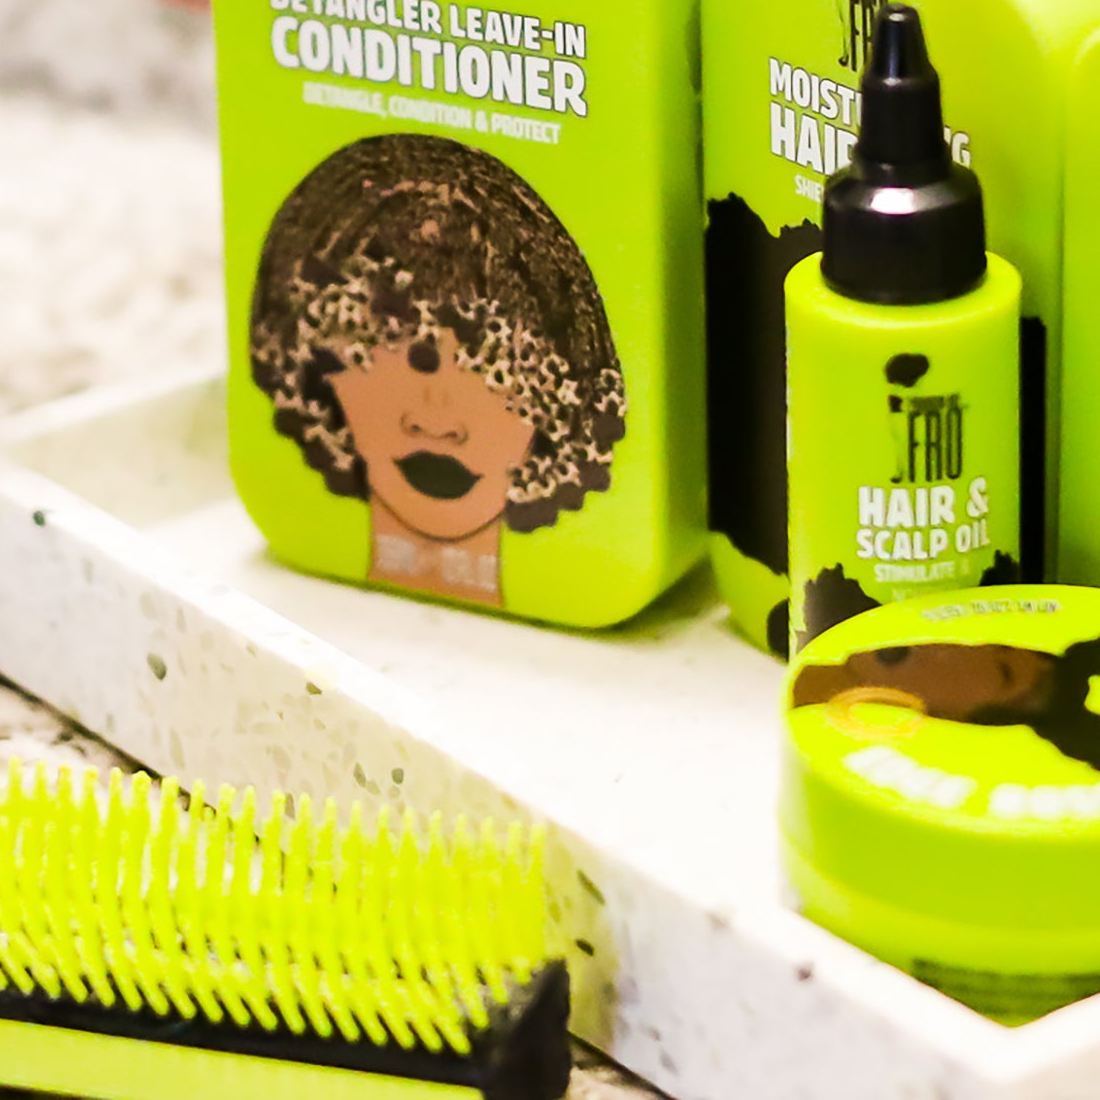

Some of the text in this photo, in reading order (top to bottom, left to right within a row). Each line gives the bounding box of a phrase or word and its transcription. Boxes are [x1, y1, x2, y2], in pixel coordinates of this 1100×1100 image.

[449, 3, 587, 59] LEAVE-IN
[270, 15, 588, 117] CONDITIONER
[388, 94, 473, 129] CONDITION
[475, 110, 489, 134] &
[490, 111, 562, 144] PROTECT
[857, 477, 989, 529] HAIR &
[855, 518, 990, 561] SCALP OIL
